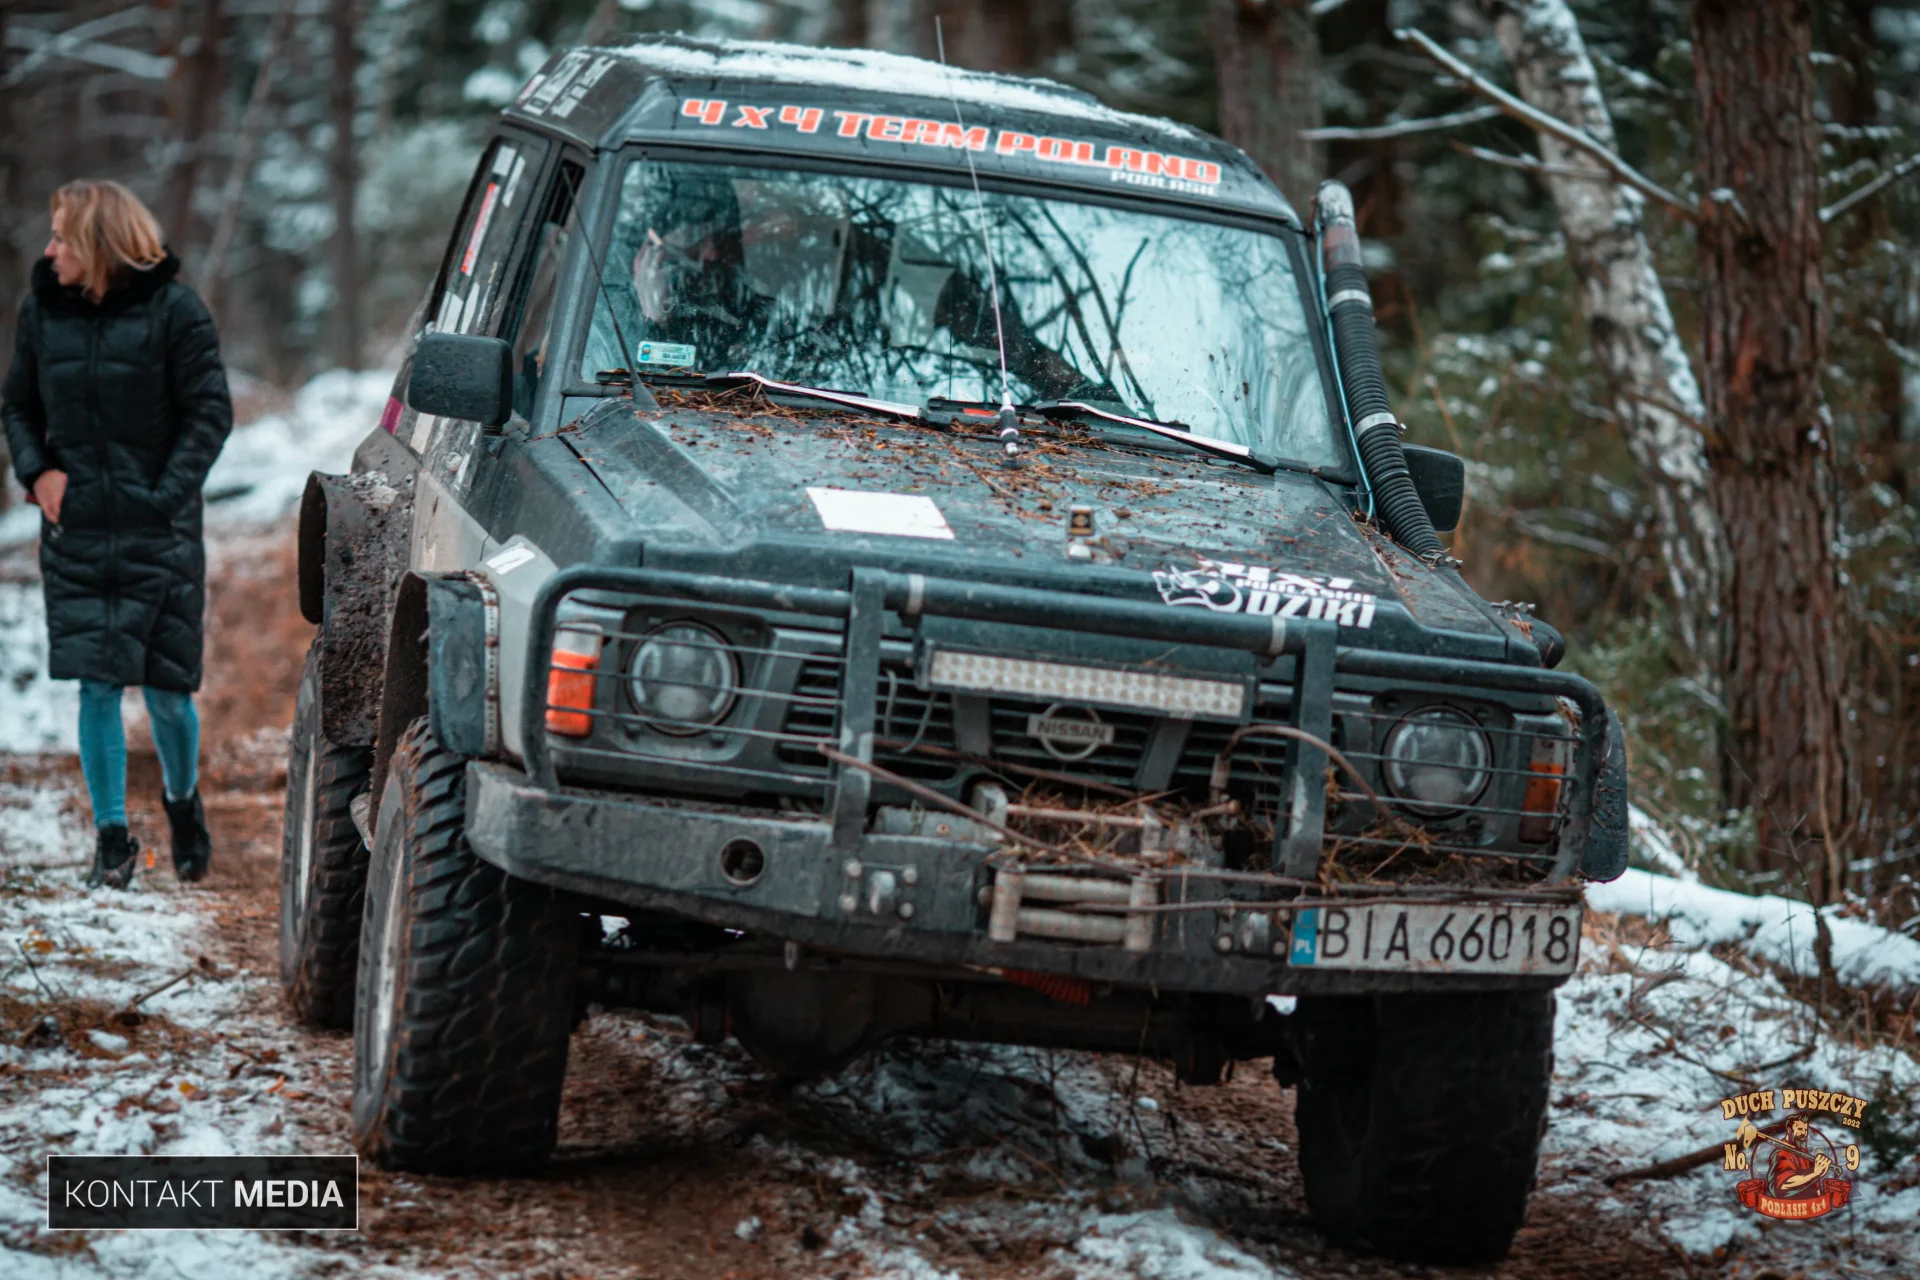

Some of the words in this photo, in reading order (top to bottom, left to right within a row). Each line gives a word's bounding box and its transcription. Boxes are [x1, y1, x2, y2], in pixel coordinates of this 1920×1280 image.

[681, 99, 728, 125] 4
[778, 105, 824, 134] 4
[833, 110, 989, 151] TEAM
[996, 130, 1221, 184] POLAND
[1245, 591, 1376, 629] DZIKI
[1038, 718, 1106, 740] NISSAN
[1294, 938, 1312, 954] PL
[1320, 908, 1411, 961] BIA
[1430, 911, 1571, 965] 66018
